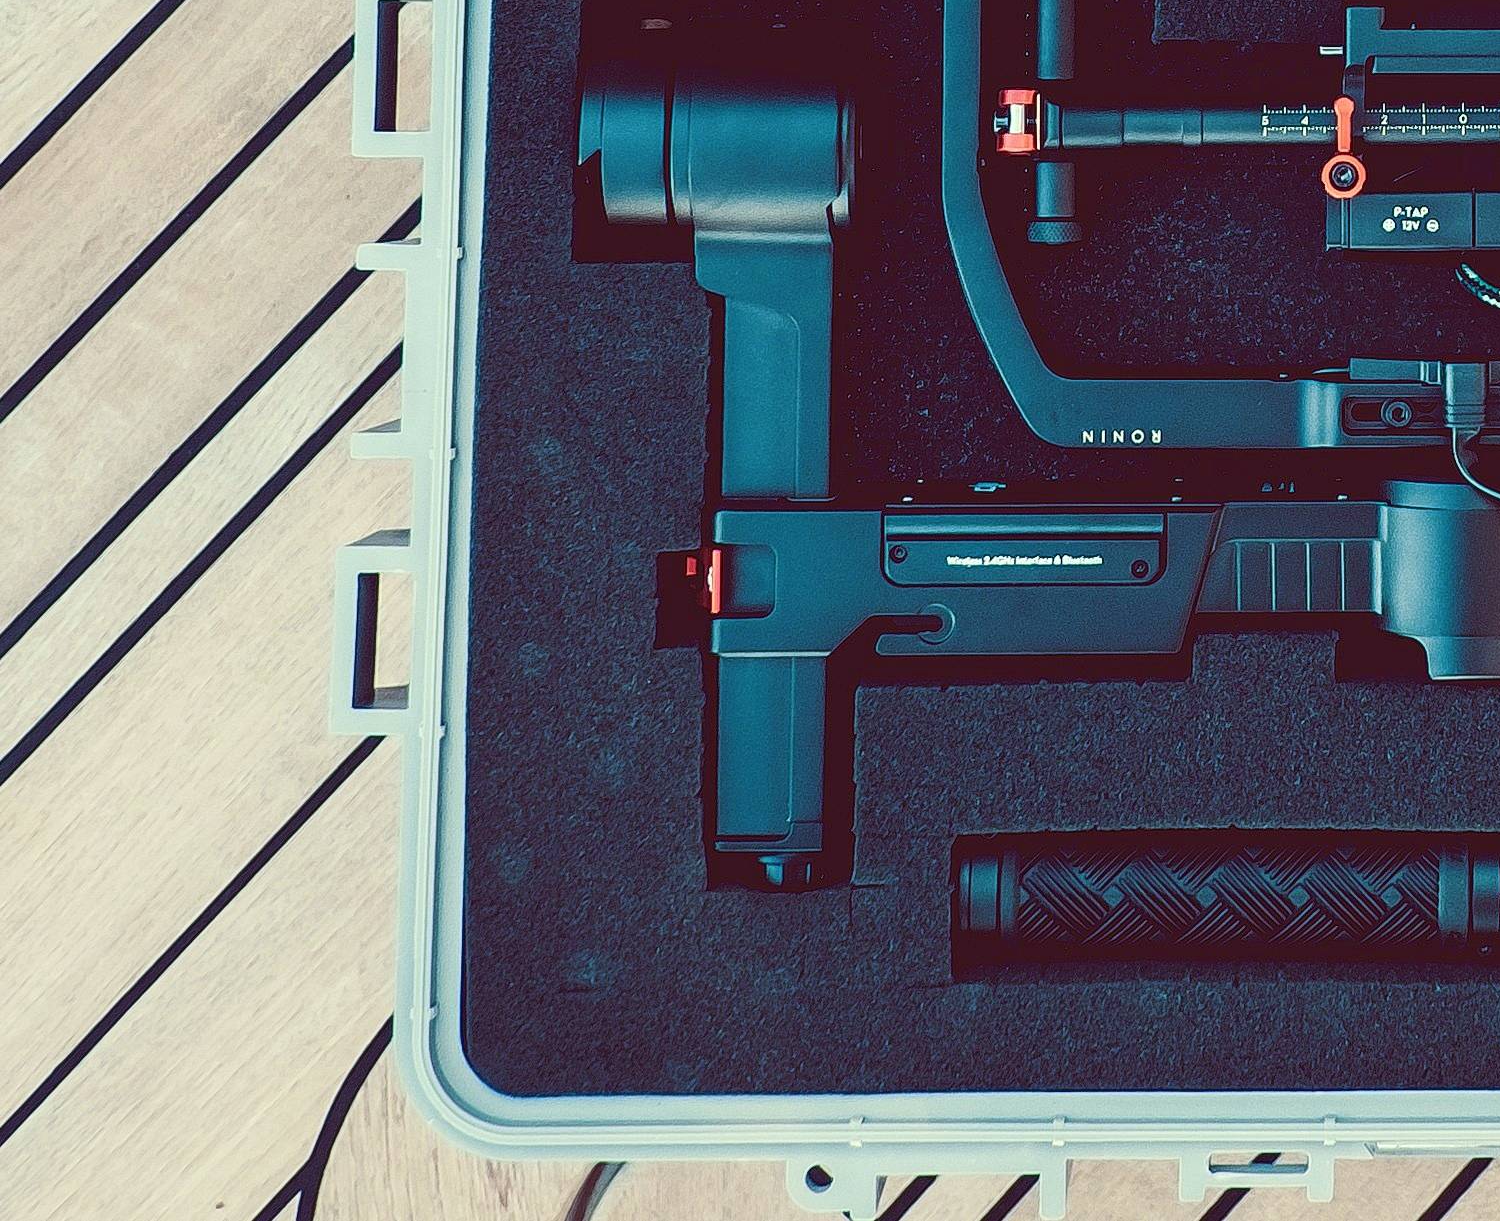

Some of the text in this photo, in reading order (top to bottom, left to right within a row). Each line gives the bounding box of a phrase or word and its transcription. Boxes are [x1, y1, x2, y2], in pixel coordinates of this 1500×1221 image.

[1261, 115, 1269, 126] 5
[1300, 115, 1309, 126] 4
[1380, 113, 1388, 125] 2
[1458, 113, 1468, 125] 0
[1393, 206, 1429, 218] P-TAP
[1082, 429, 1162, 444] RONIN
